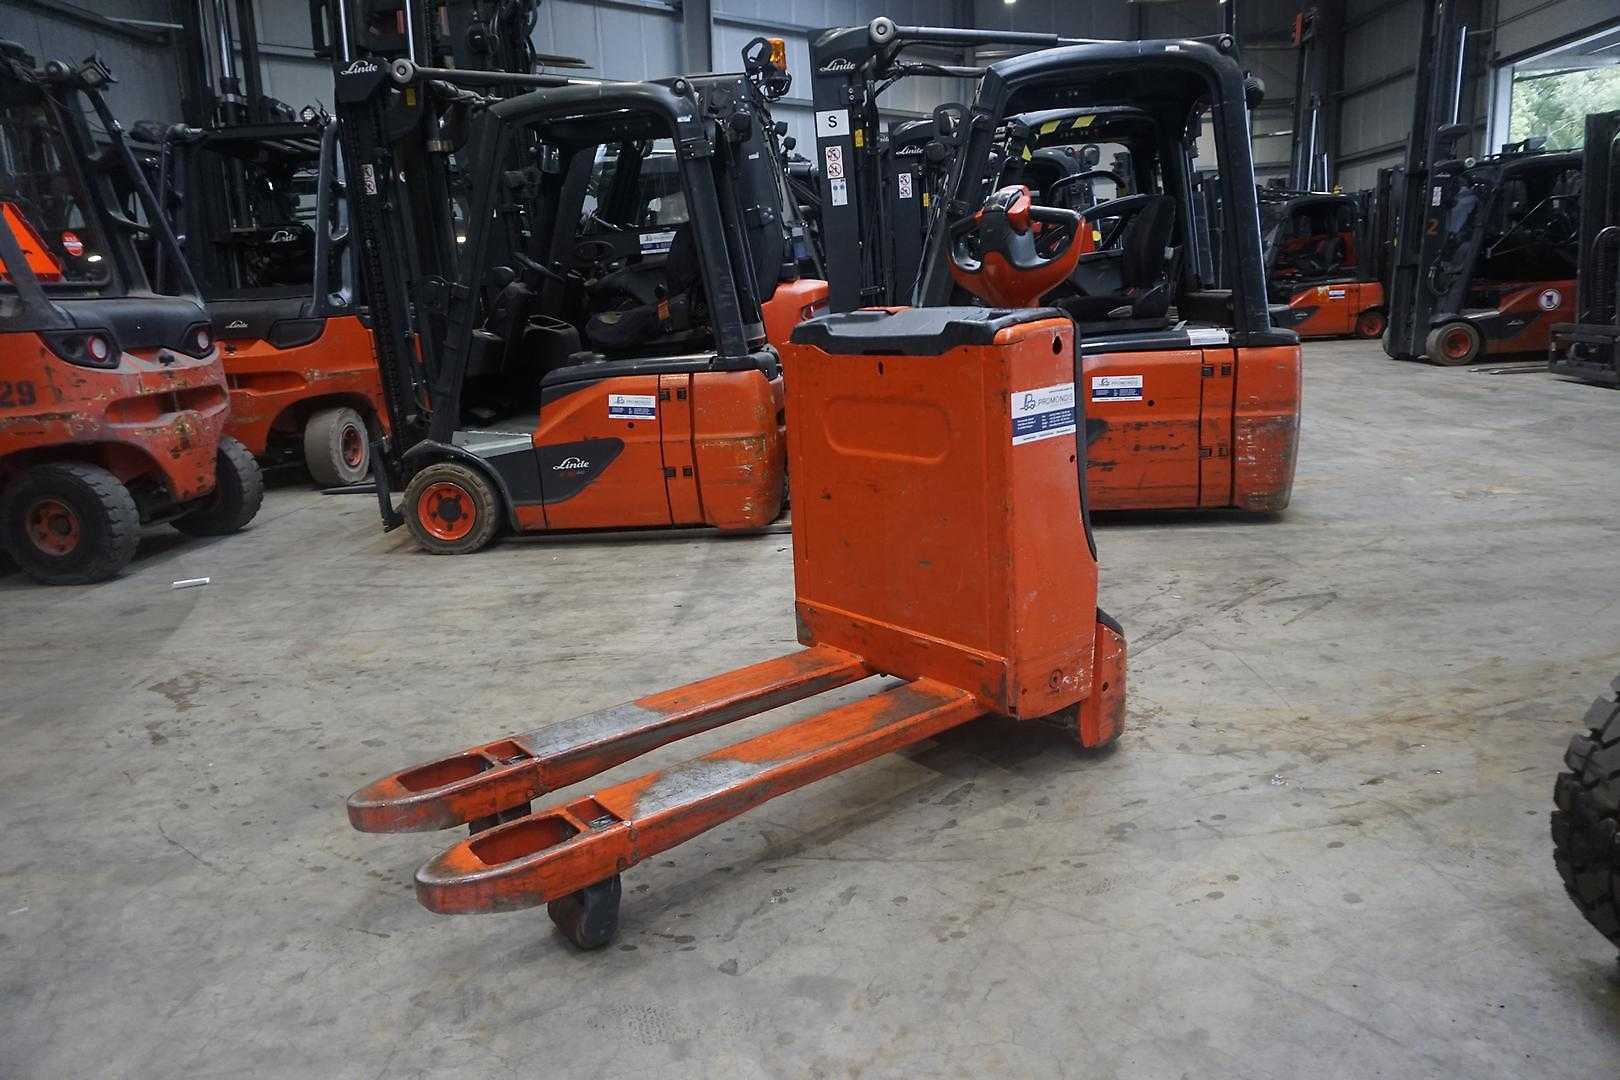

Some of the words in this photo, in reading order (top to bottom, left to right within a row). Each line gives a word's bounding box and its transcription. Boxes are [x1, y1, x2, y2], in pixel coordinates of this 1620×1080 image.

[340, 59, 378, 75] Linde
[820, 57, 856, 72] Linde
[828, 115, 837, 128] S
[552, 456, 591, 470] Linde
